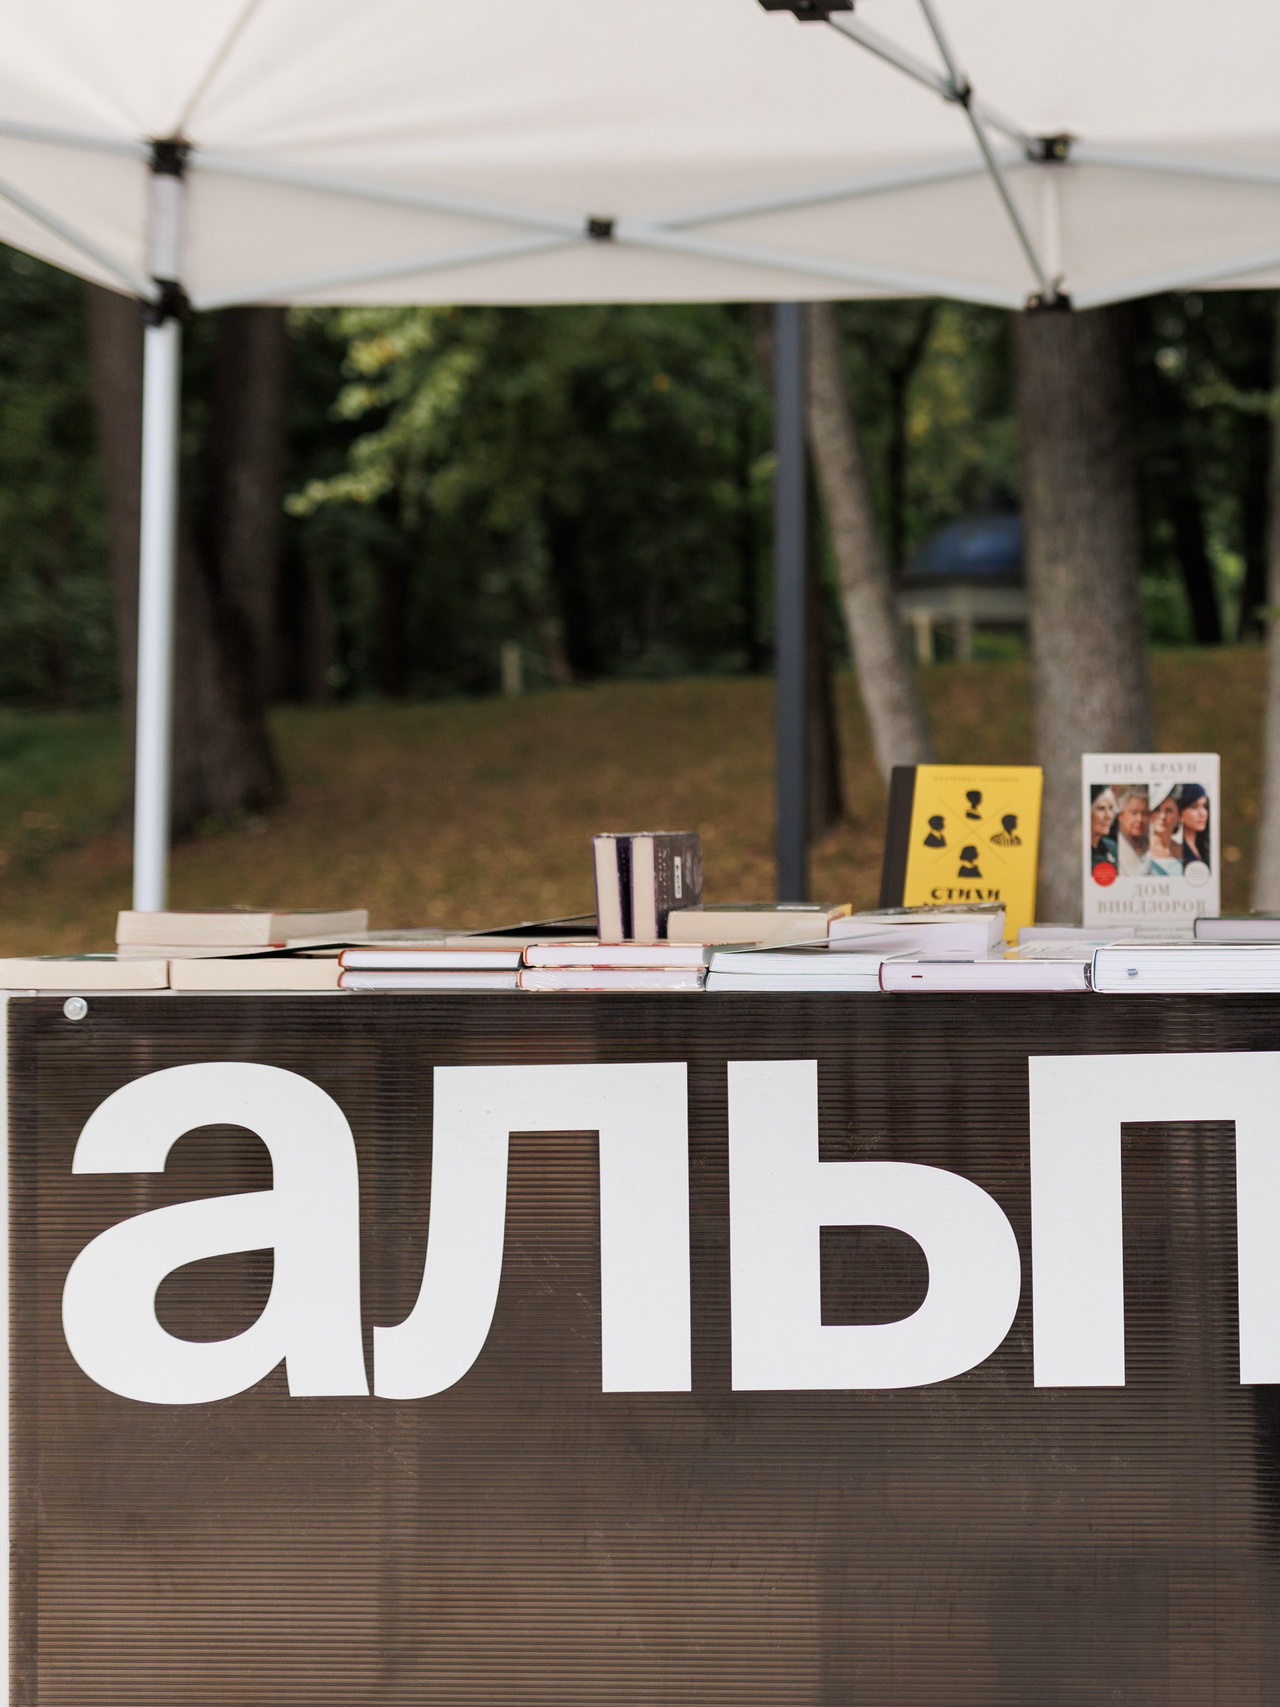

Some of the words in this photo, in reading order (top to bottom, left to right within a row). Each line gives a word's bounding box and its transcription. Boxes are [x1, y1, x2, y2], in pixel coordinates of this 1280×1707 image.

[931, 886, 1001, 901] СТИХИ
[1133, 883, 1171, 899] ДОМ
[1096, 900, 1207, 915] ВИНДЗОРОВ
